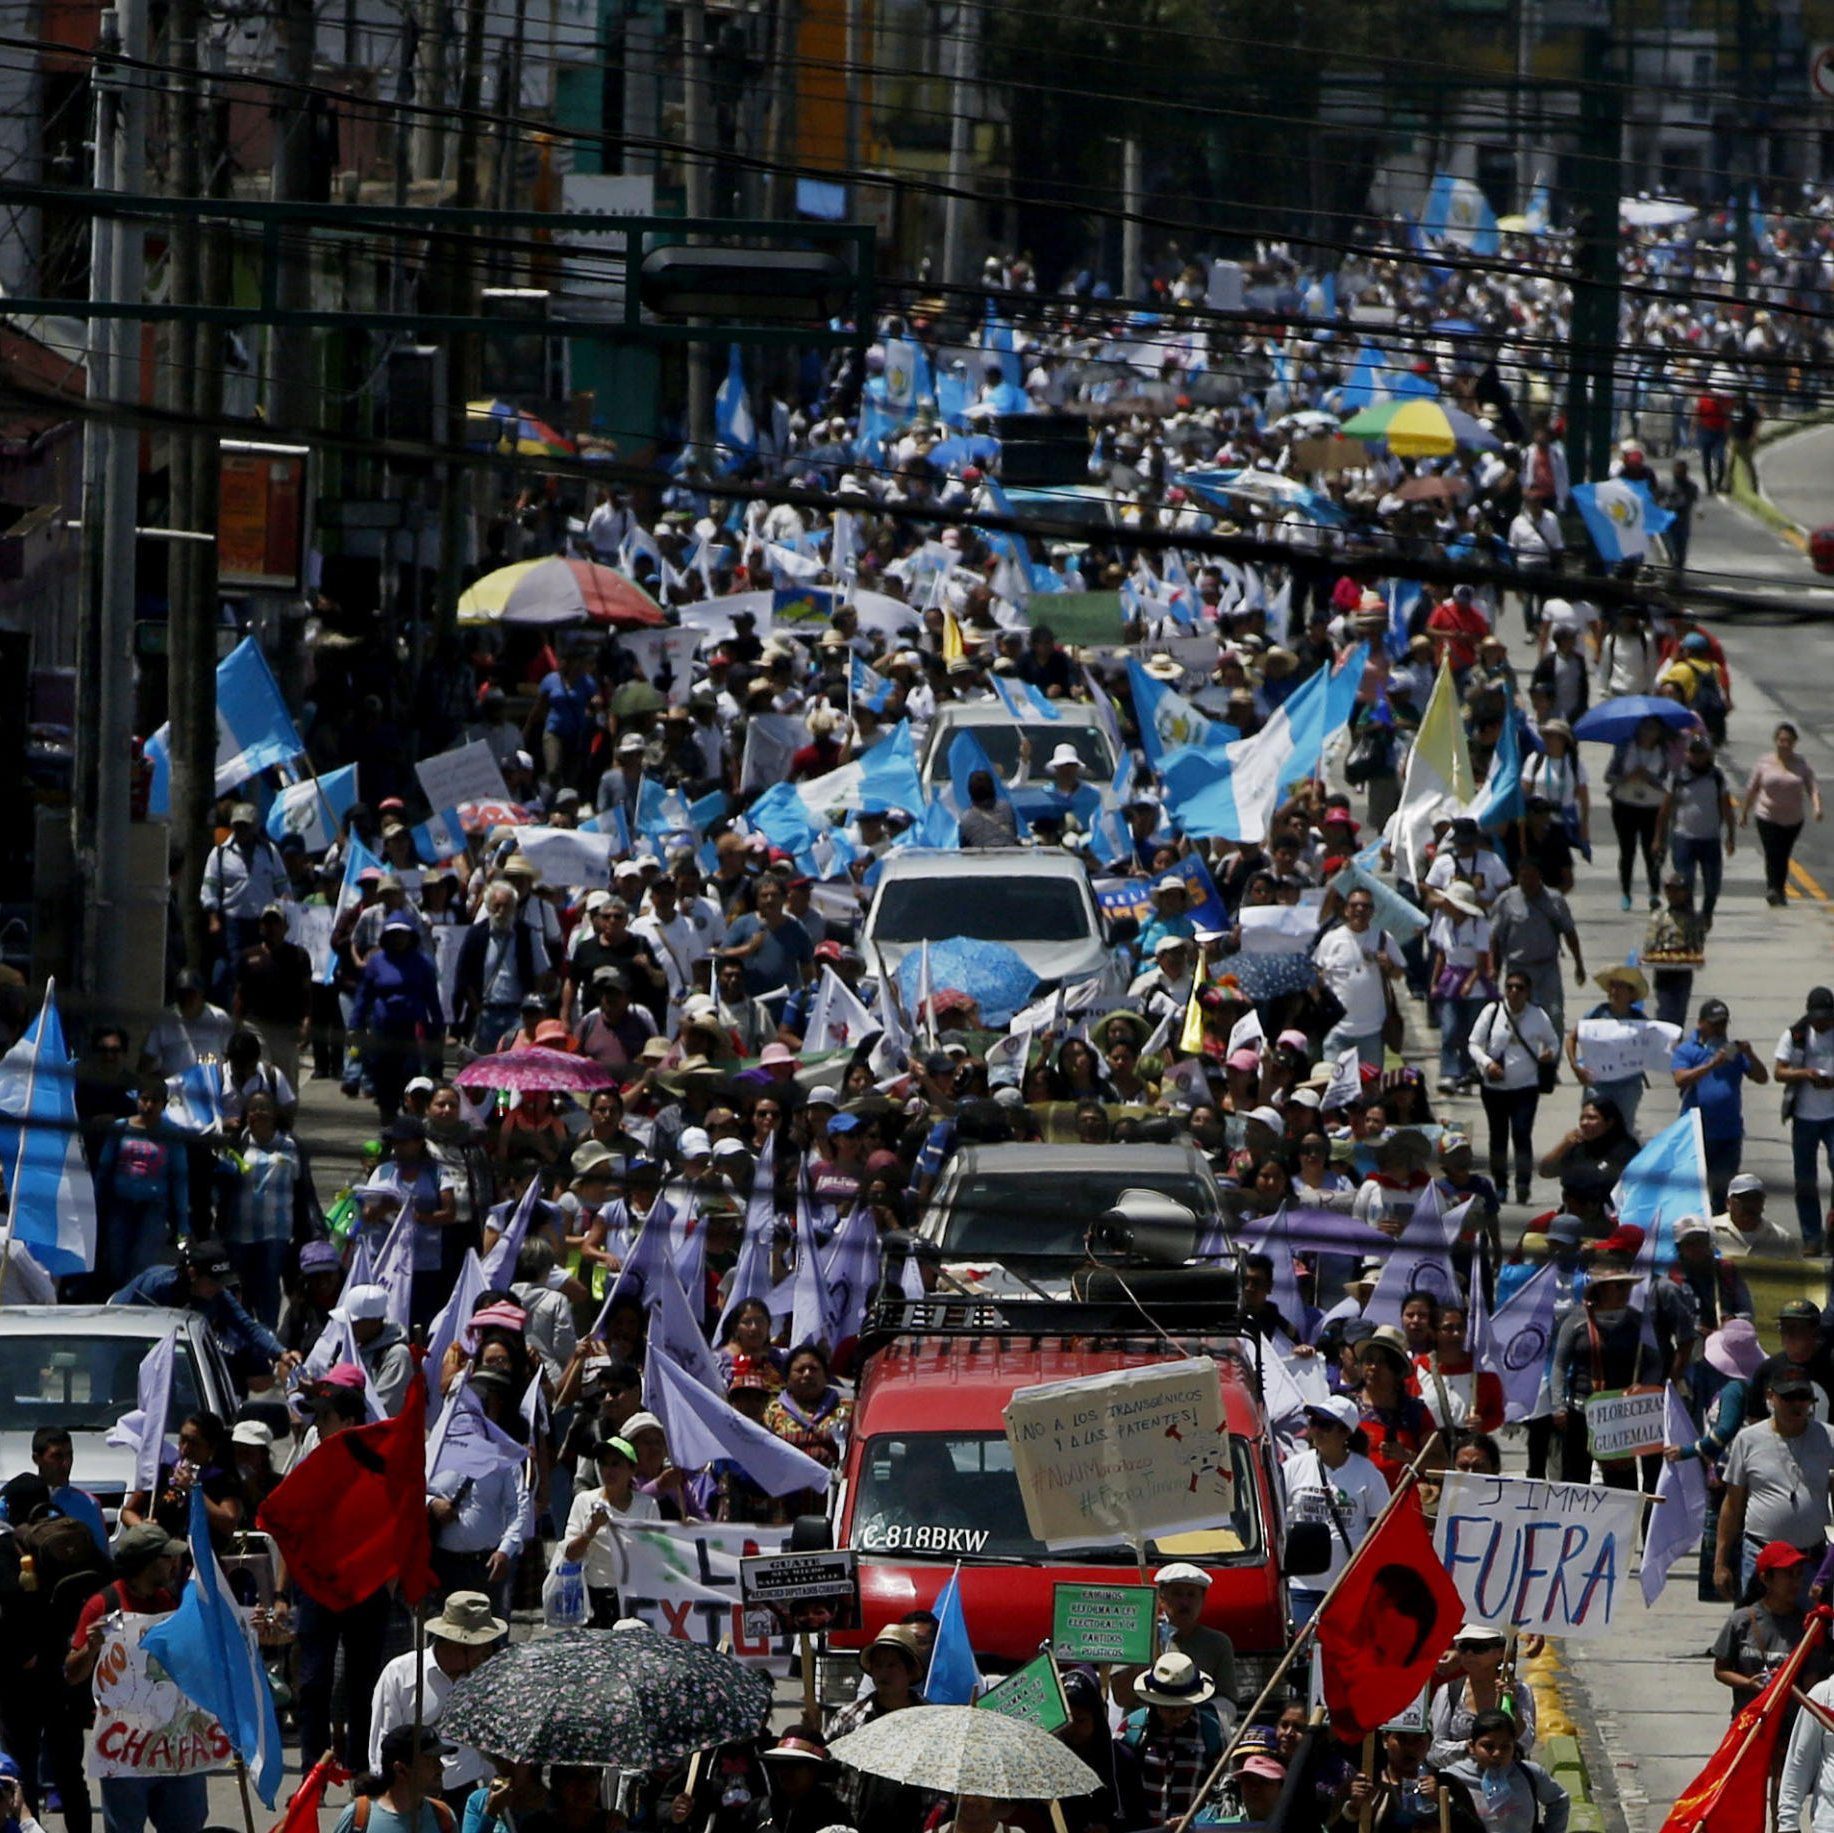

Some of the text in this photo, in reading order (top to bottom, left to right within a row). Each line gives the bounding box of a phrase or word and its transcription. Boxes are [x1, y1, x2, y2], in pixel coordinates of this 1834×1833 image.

[1054, 1419, 1065, 1432] A
[1073, 1410, 1098, 1428] LOS
[1084, 1428, 1108, 1446] LAS
[1594, 1424, 1664, 1452] GUATEMALA
[1478, 1478, 1609, 1513] JIMMY
[861, 1523, 990, 1552] C-818BKW
[1444, 1515, 1617, 1627] FUERA
[1081, 1632, 1124, 1644] PARTIDOS
[96, 1641, 128, 1693] NO
